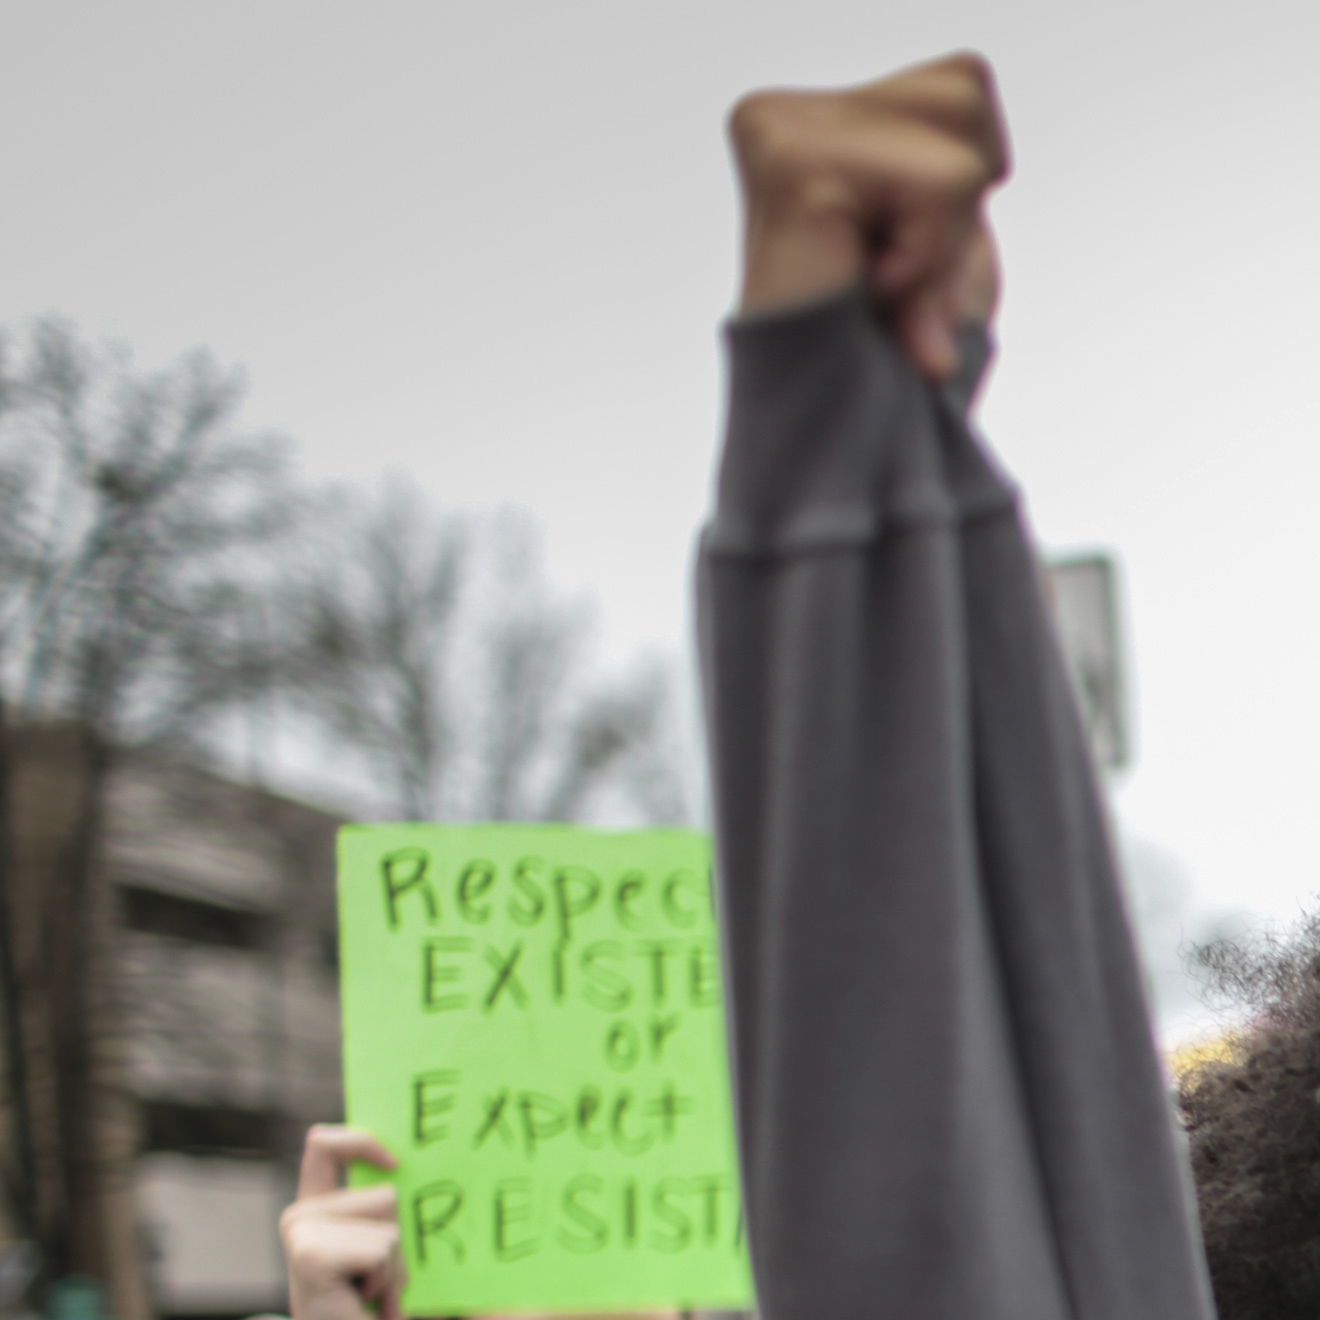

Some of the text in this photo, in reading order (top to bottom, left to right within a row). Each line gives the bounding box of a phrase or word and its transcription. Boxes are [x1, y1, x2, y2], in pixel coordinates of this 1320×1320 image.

[603, 1012, 680, 1072] or
[413, 1069, 693, 1156] Expect
[411, 1171, 744, 1267] RESIST
